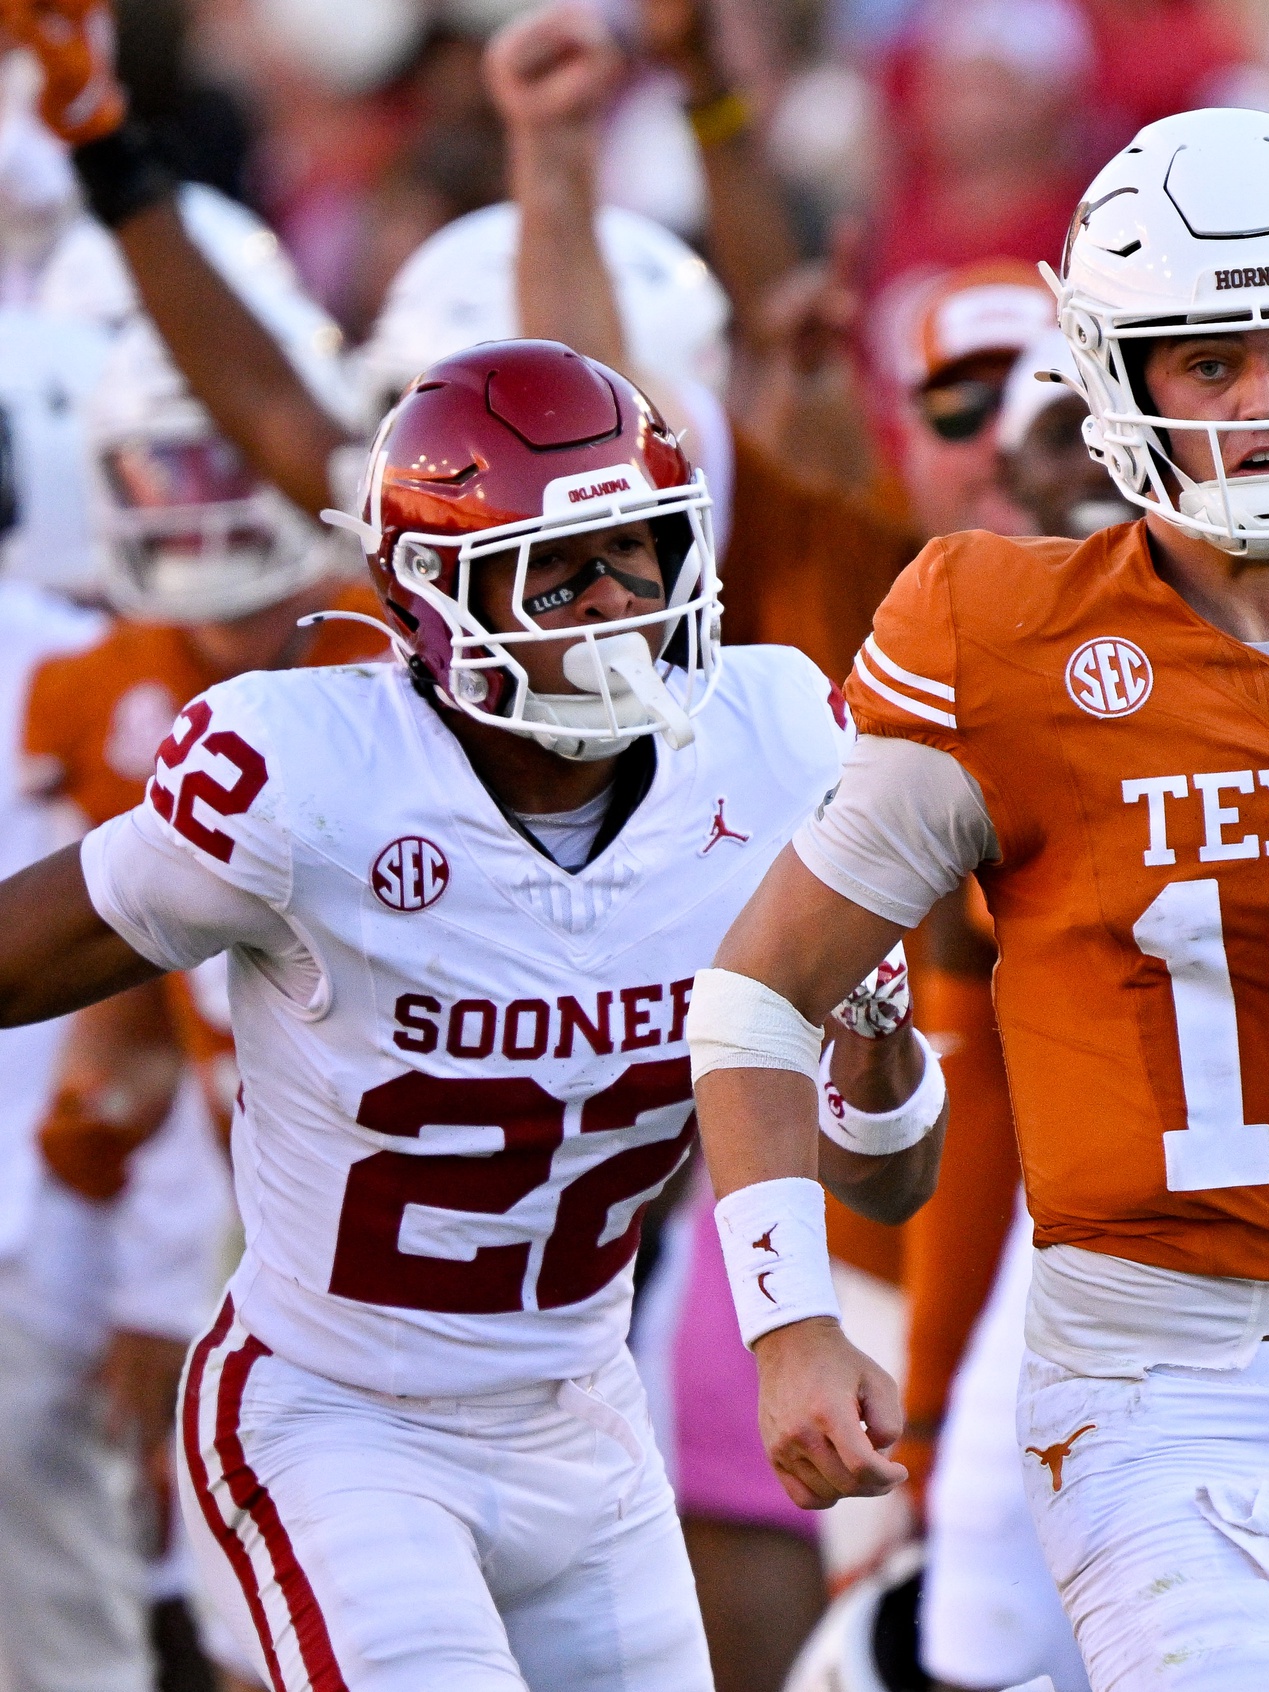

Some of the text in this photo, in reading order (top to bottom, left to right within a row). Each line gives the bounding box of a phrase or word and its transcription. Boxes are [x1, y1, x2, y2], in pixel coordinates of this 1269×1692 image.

[568, 478, 631, 503] OKLAHOMA
[1073, 643, 1146, 711] SEC
[150, 700, 269, 864] 22
[377, 840, 444, 908] SEC
[393, 976, 695, 1060] SOONE
[328, 1055, 696, 1314] 22
